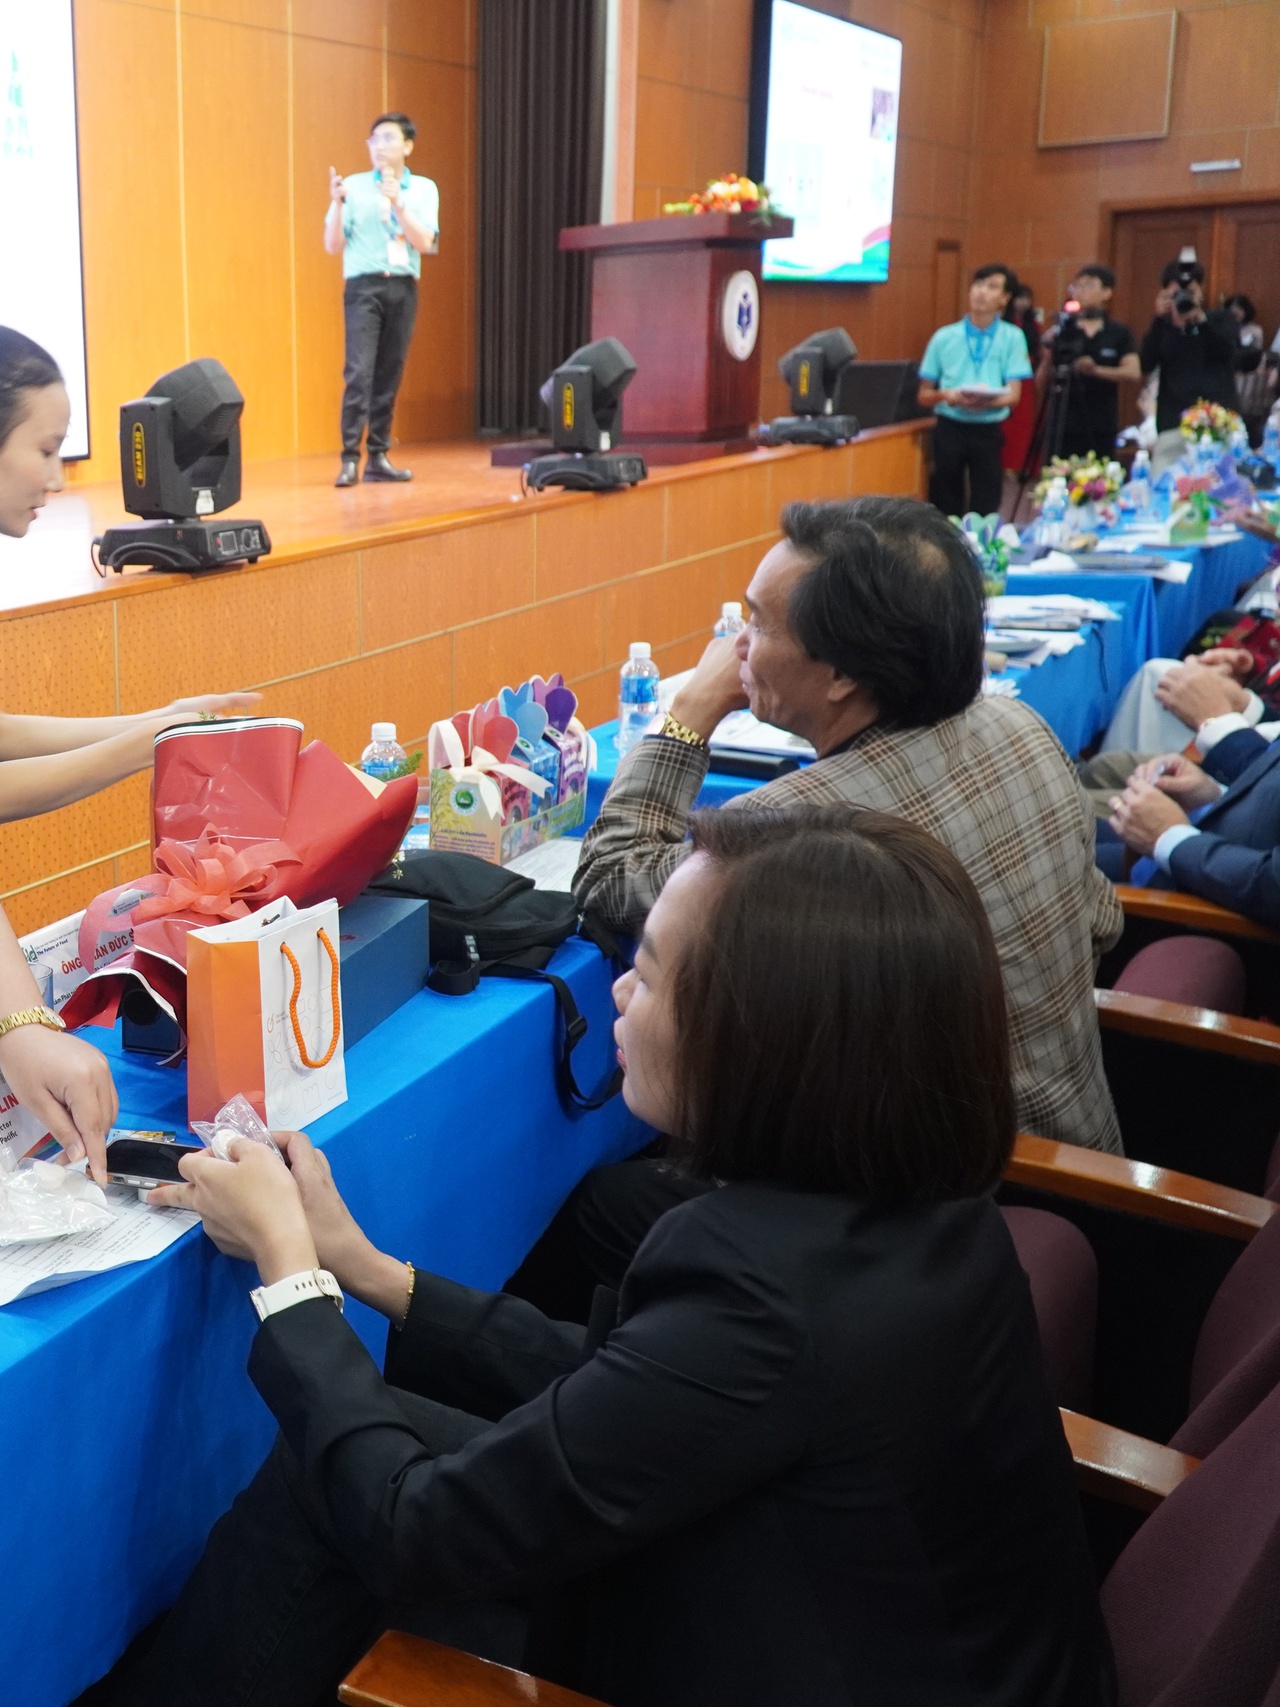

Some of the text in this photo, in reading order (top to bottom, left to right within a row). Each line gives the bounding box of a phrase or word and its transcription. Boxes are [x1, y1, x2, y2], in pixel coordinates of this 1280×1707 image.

[61, 956, 83, 975] ÔNG
[108, 935, 129, 953] ĐỨC
[0, 1130, 18, 1144] Pacific
